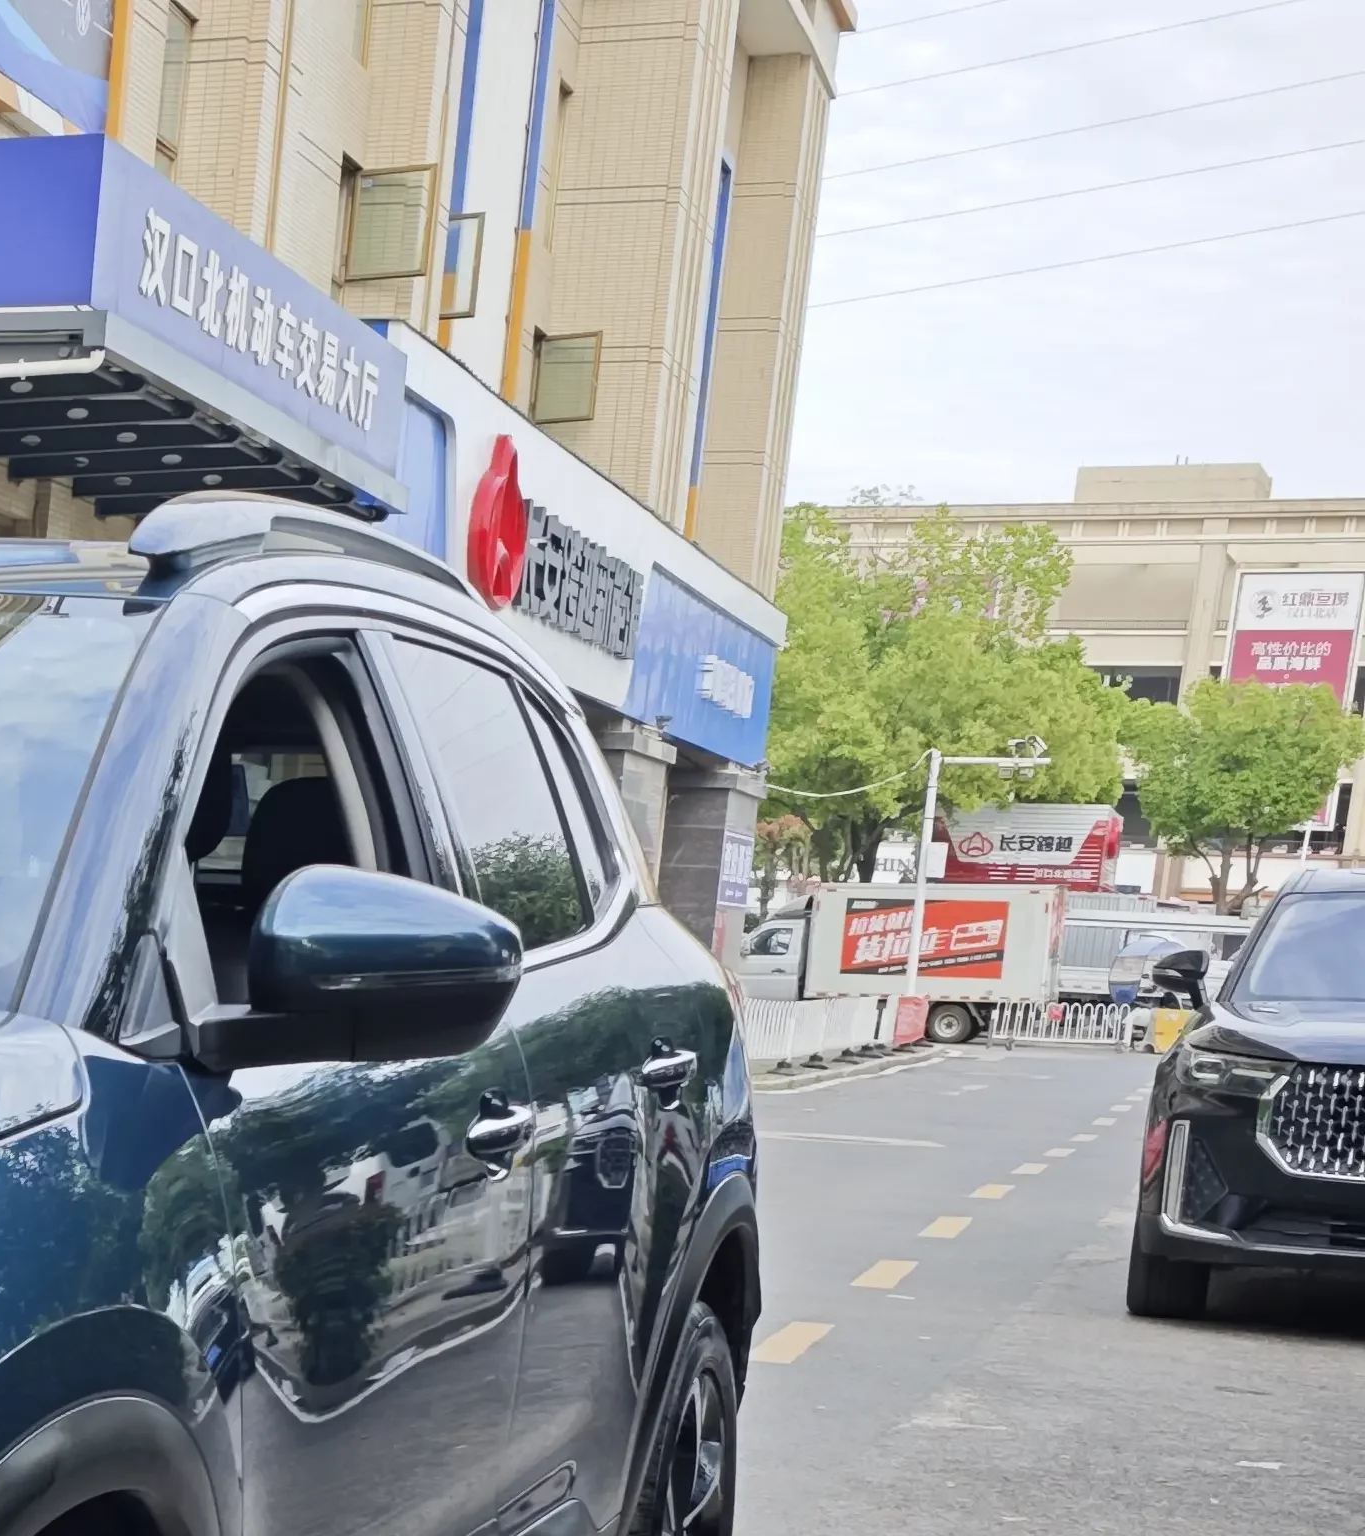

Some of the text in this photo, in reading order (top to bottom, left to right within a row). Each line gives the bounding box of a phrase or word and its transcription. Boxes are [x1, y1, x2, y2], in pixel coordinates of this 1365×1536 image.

[138, 206, 379, 431] 汉口北机动车交易大厅
[1251, 641, 1332, 656] 高性价比的
[999, 834, 1073, 852] 长安跨越
